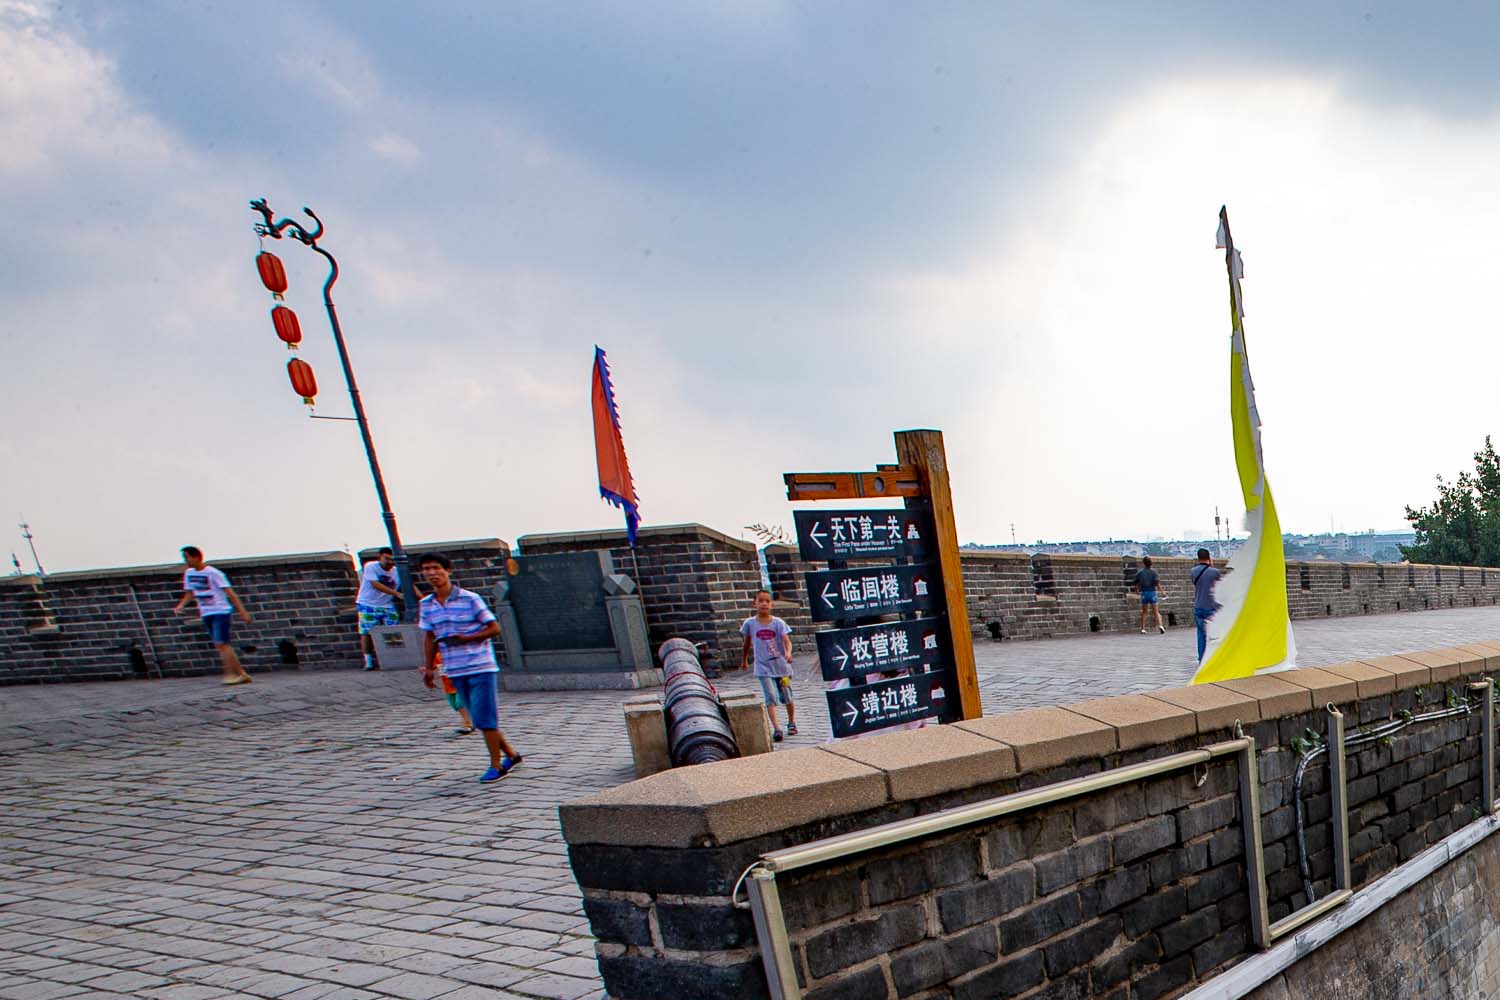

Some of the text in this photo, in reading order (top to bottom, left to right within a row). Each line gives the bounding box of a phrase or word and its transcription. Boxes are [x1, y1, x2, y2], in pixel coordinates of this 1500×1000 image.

[831, 515, 902, 541] 天下第一关
[840, 574, 900, 602] 临闾楼
[851, 630, 909, 661] 牧营楼
[861, 683, 918, 715] 靖边楼
